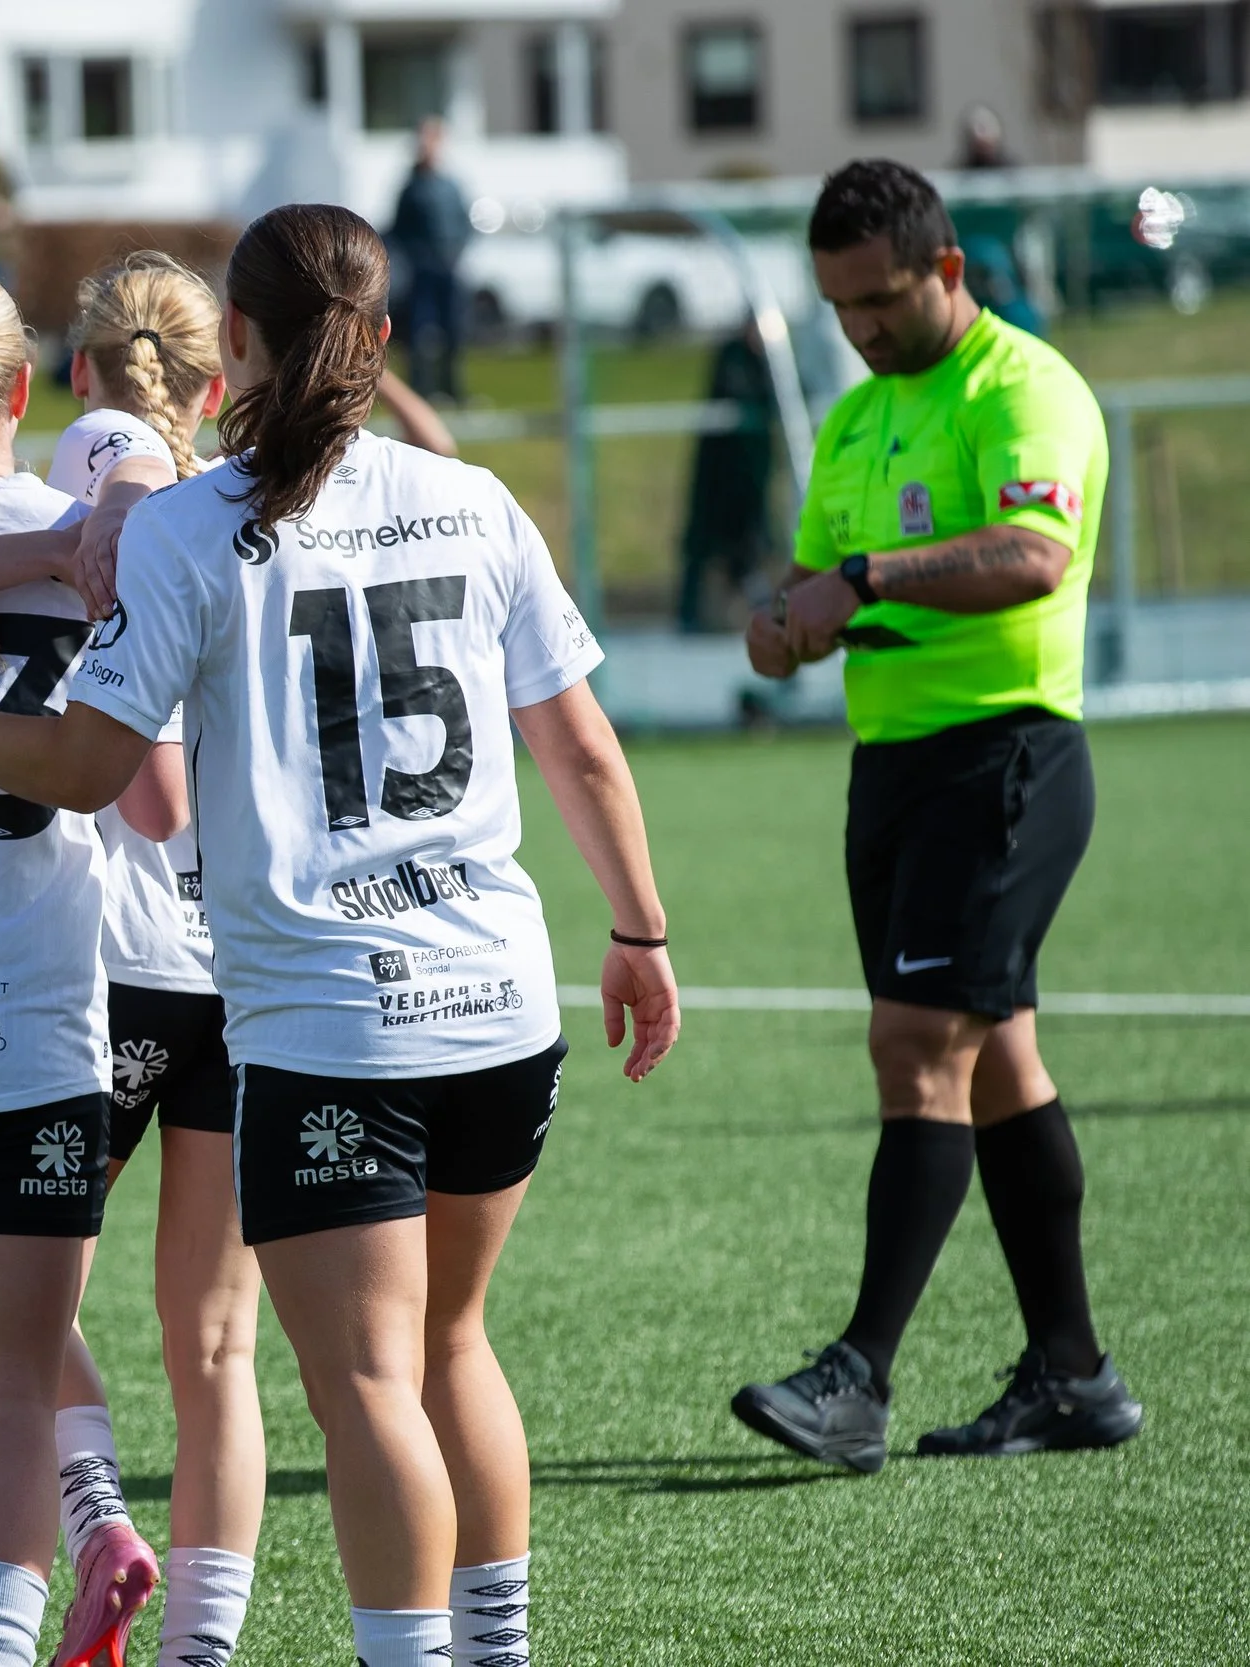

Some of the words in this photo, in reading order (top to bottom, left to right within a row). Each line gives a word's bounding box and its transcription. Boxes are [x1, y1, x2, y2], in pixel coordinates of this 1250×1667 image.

[295, 508, 486, 559] Sognekraft
[87, 659, 125, 687] Sogn
[288, 575, 474, 832] 15
[331, 860, 480, 921] Skjølberg
[411, 938, 508, 964] FAGFORBUNDET
[415, 963, 451, 977] Sogndal
[382, 995, 495, 1027] KREFTTRÅKK
[110, 1089, 150, 1110] esta
[295, 1157, 379, 1186] mesta
[19, 1176, 88, 1196] mesta
